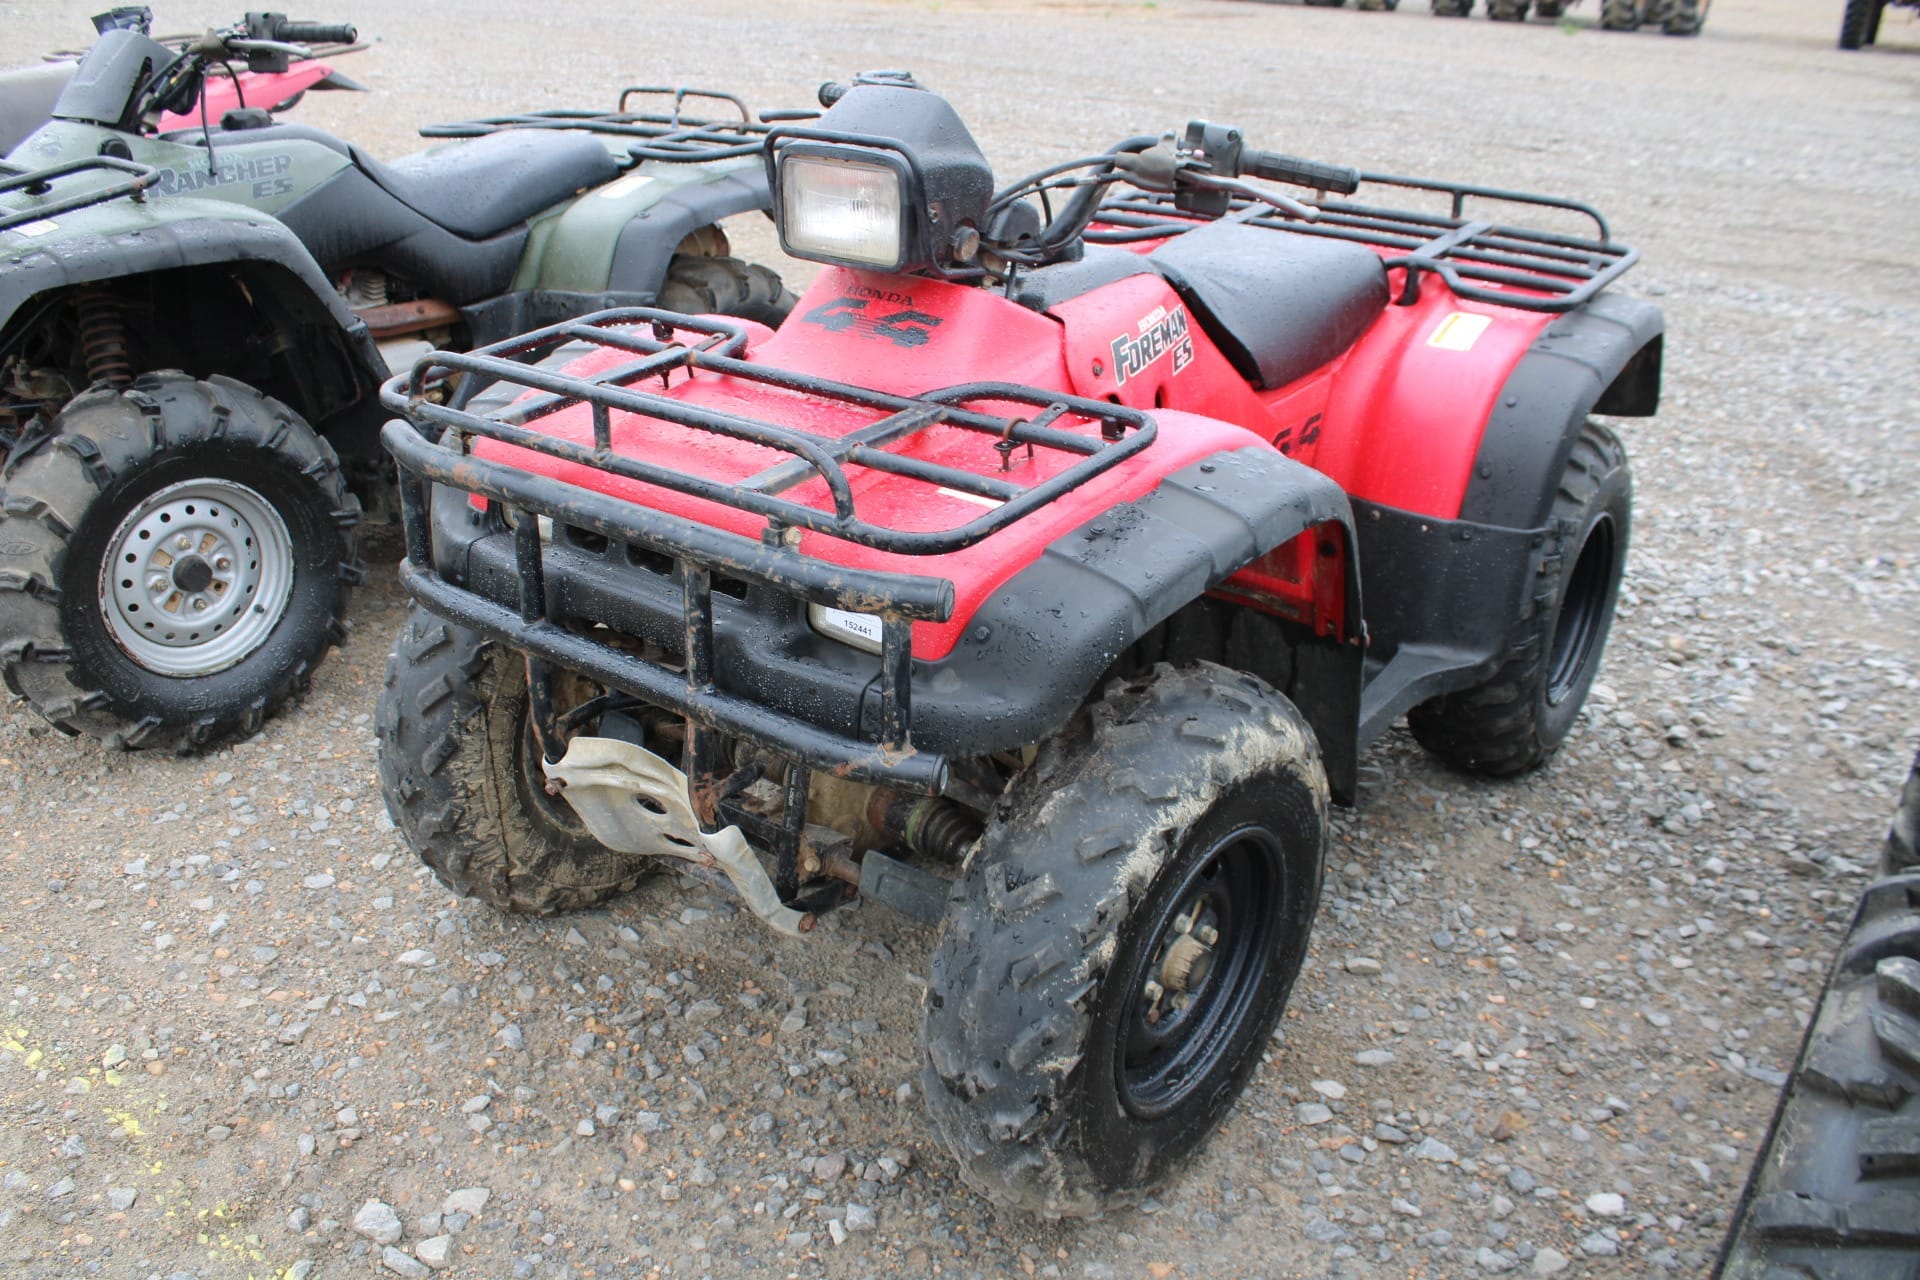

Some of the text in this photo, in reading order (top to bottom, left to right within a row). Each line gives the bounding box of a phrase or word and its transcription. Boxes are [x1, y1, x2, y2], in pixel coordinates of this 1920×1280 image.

[149, 154, 293, 199] RANCHER
[252, 177, 293, 199] ES
[845, 285, 914, 307] HONDA
[1111, 304, 1189, 387] FOREMAN
[1172, 335, 1195, 376] ES
[843, 619, 873, 637] 152441
